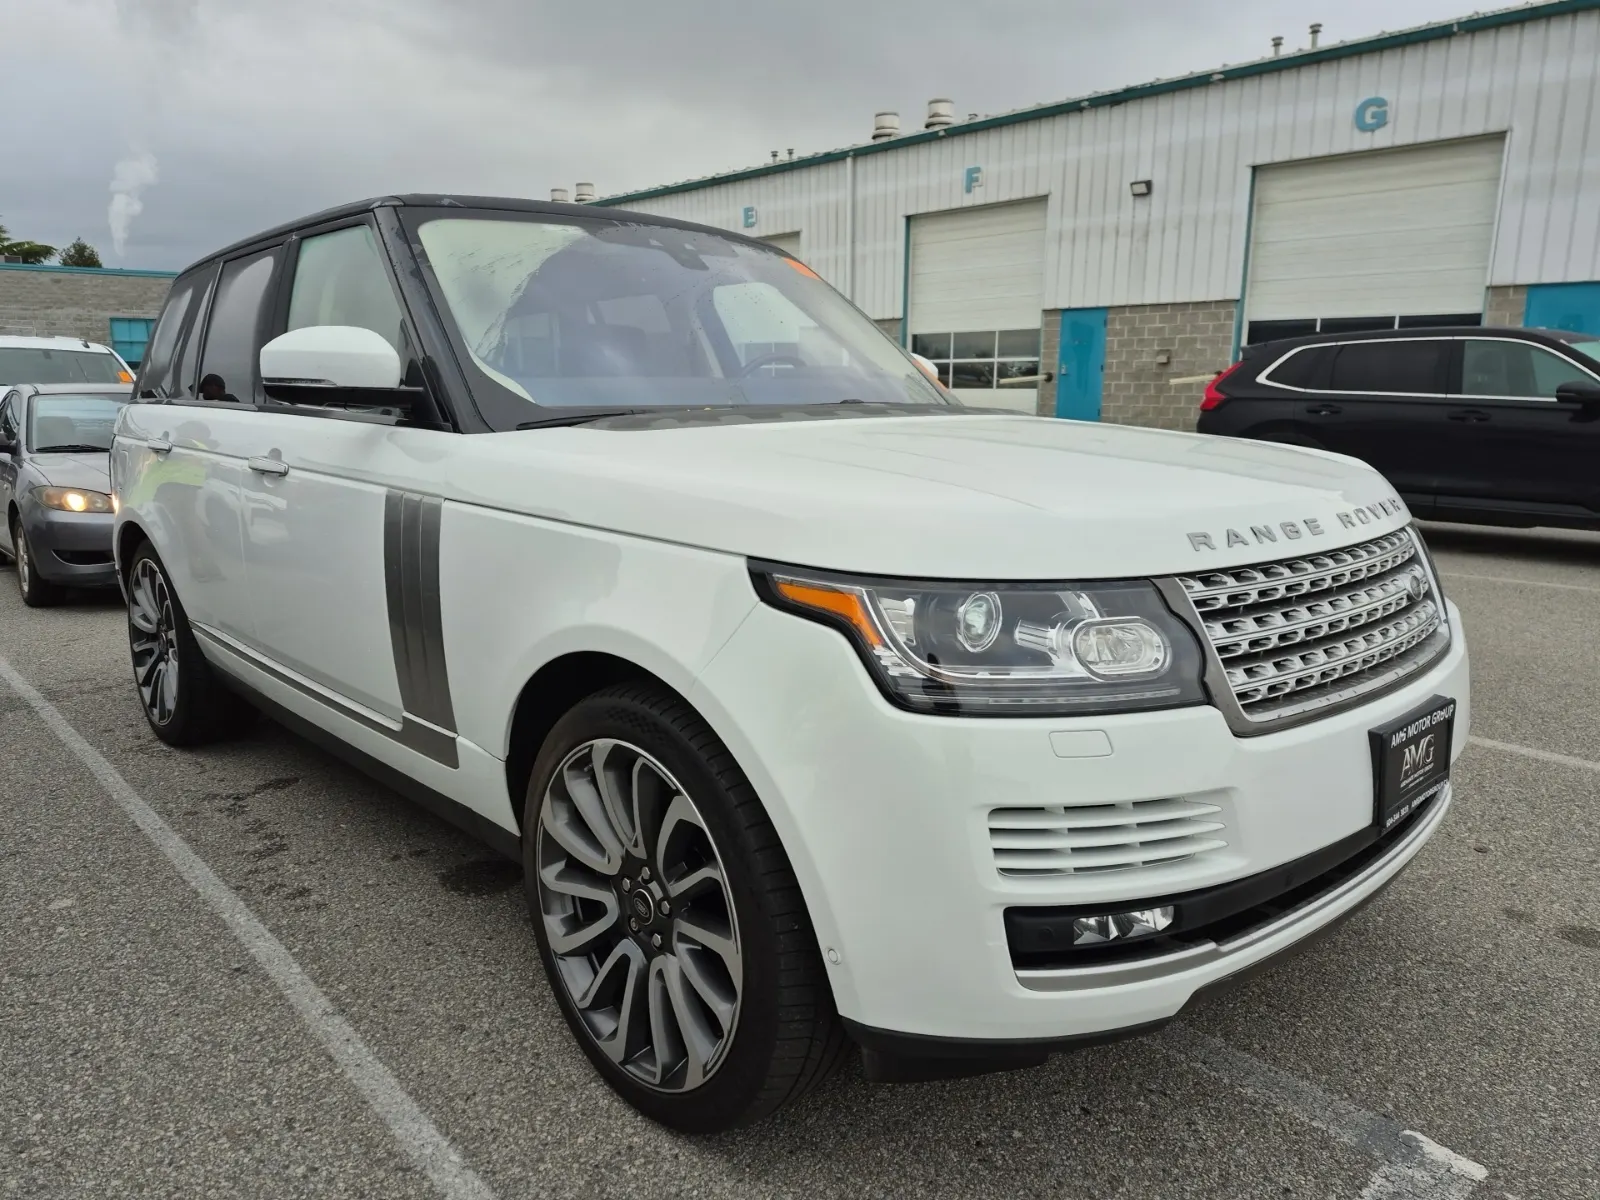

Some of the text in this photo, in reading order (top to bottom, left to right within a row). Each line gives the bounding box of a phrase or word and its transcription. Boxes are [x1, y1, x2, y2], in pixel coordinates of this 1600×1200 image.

[1355, 96, 1388, 132] G
[965, 166, 981, 193] F
[743, 206, 755, 228] E
[1186, 497, 1401, 552] RANGE ROVER
[1390, 704, 1454, 749] AMS MOTOR GROUP
[1400, 734, 1435, 781] AMG
